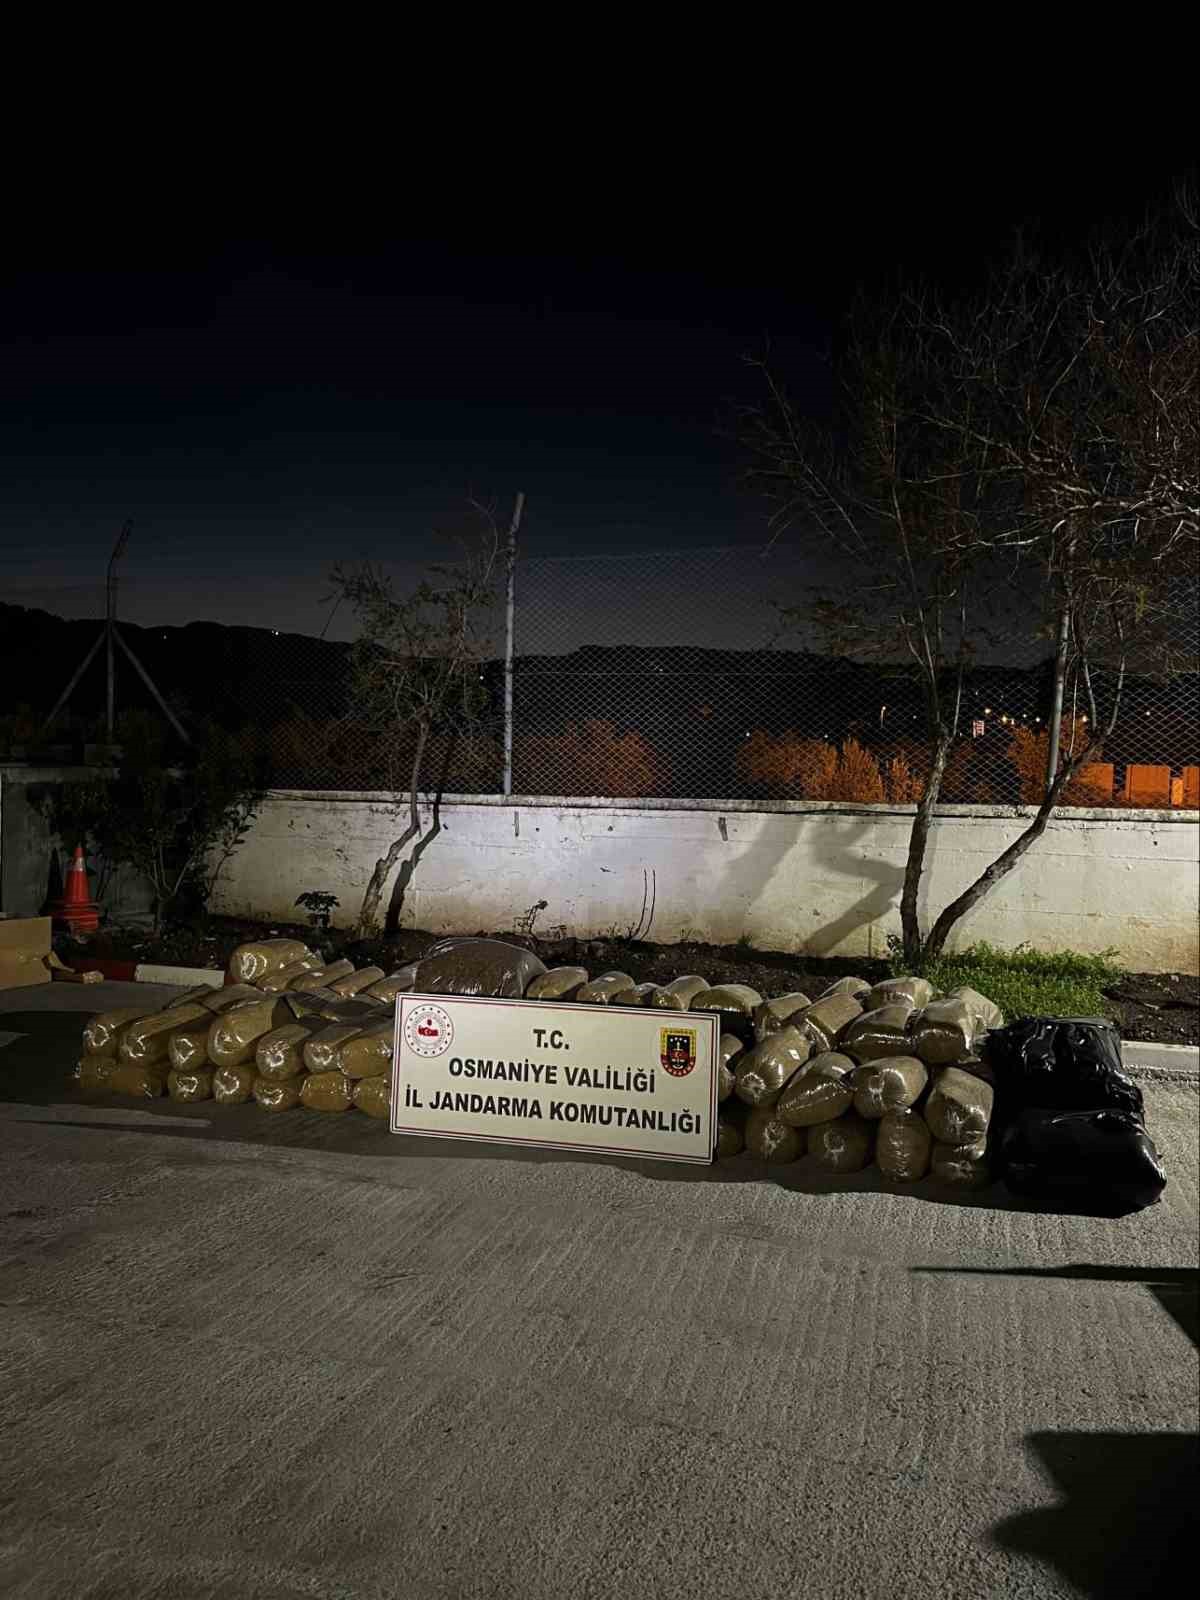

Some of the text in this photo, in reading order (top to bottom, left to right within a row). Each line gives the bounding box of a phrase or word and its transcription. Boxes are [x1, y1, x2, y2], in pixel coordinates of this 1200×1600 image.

[533, 1028, 570, 1050] T.C.
[449, 1058, 558, 1085] OSMANİYE
[564, 1065, 656, 1094] VALİLİĞİ
[405, 1083, 701, 1135] İL JANDARMA KOMUTANLIĞI
